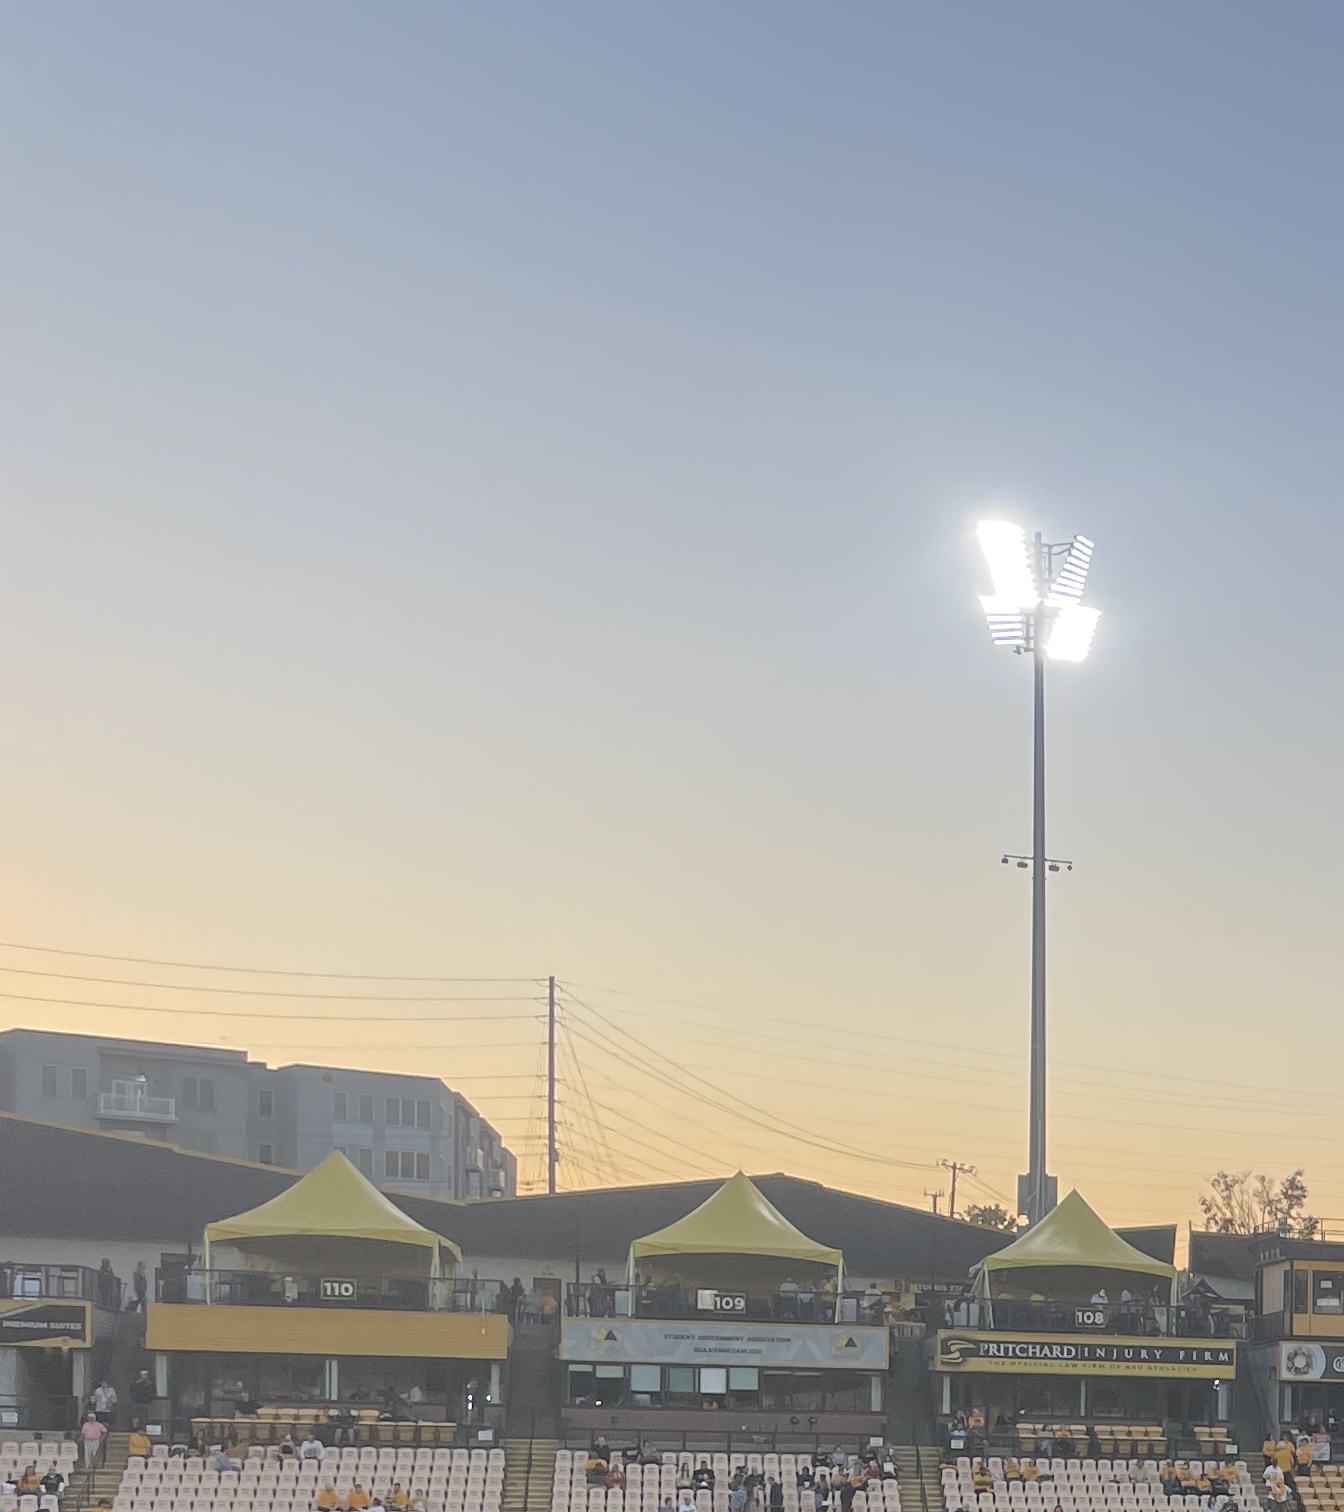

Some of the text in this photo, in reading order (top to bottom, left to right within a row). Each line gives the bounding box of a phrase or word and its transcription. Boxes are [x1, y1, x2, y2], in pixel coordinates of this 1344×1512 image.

[323, 1282, 354, 1296] 110
[714, 1297, 745, 1310] 109
[1077, 1311, 1105, 1324] 108
[979, 1343, 1230, 1361] PRITCHARD INJURY FIRM
